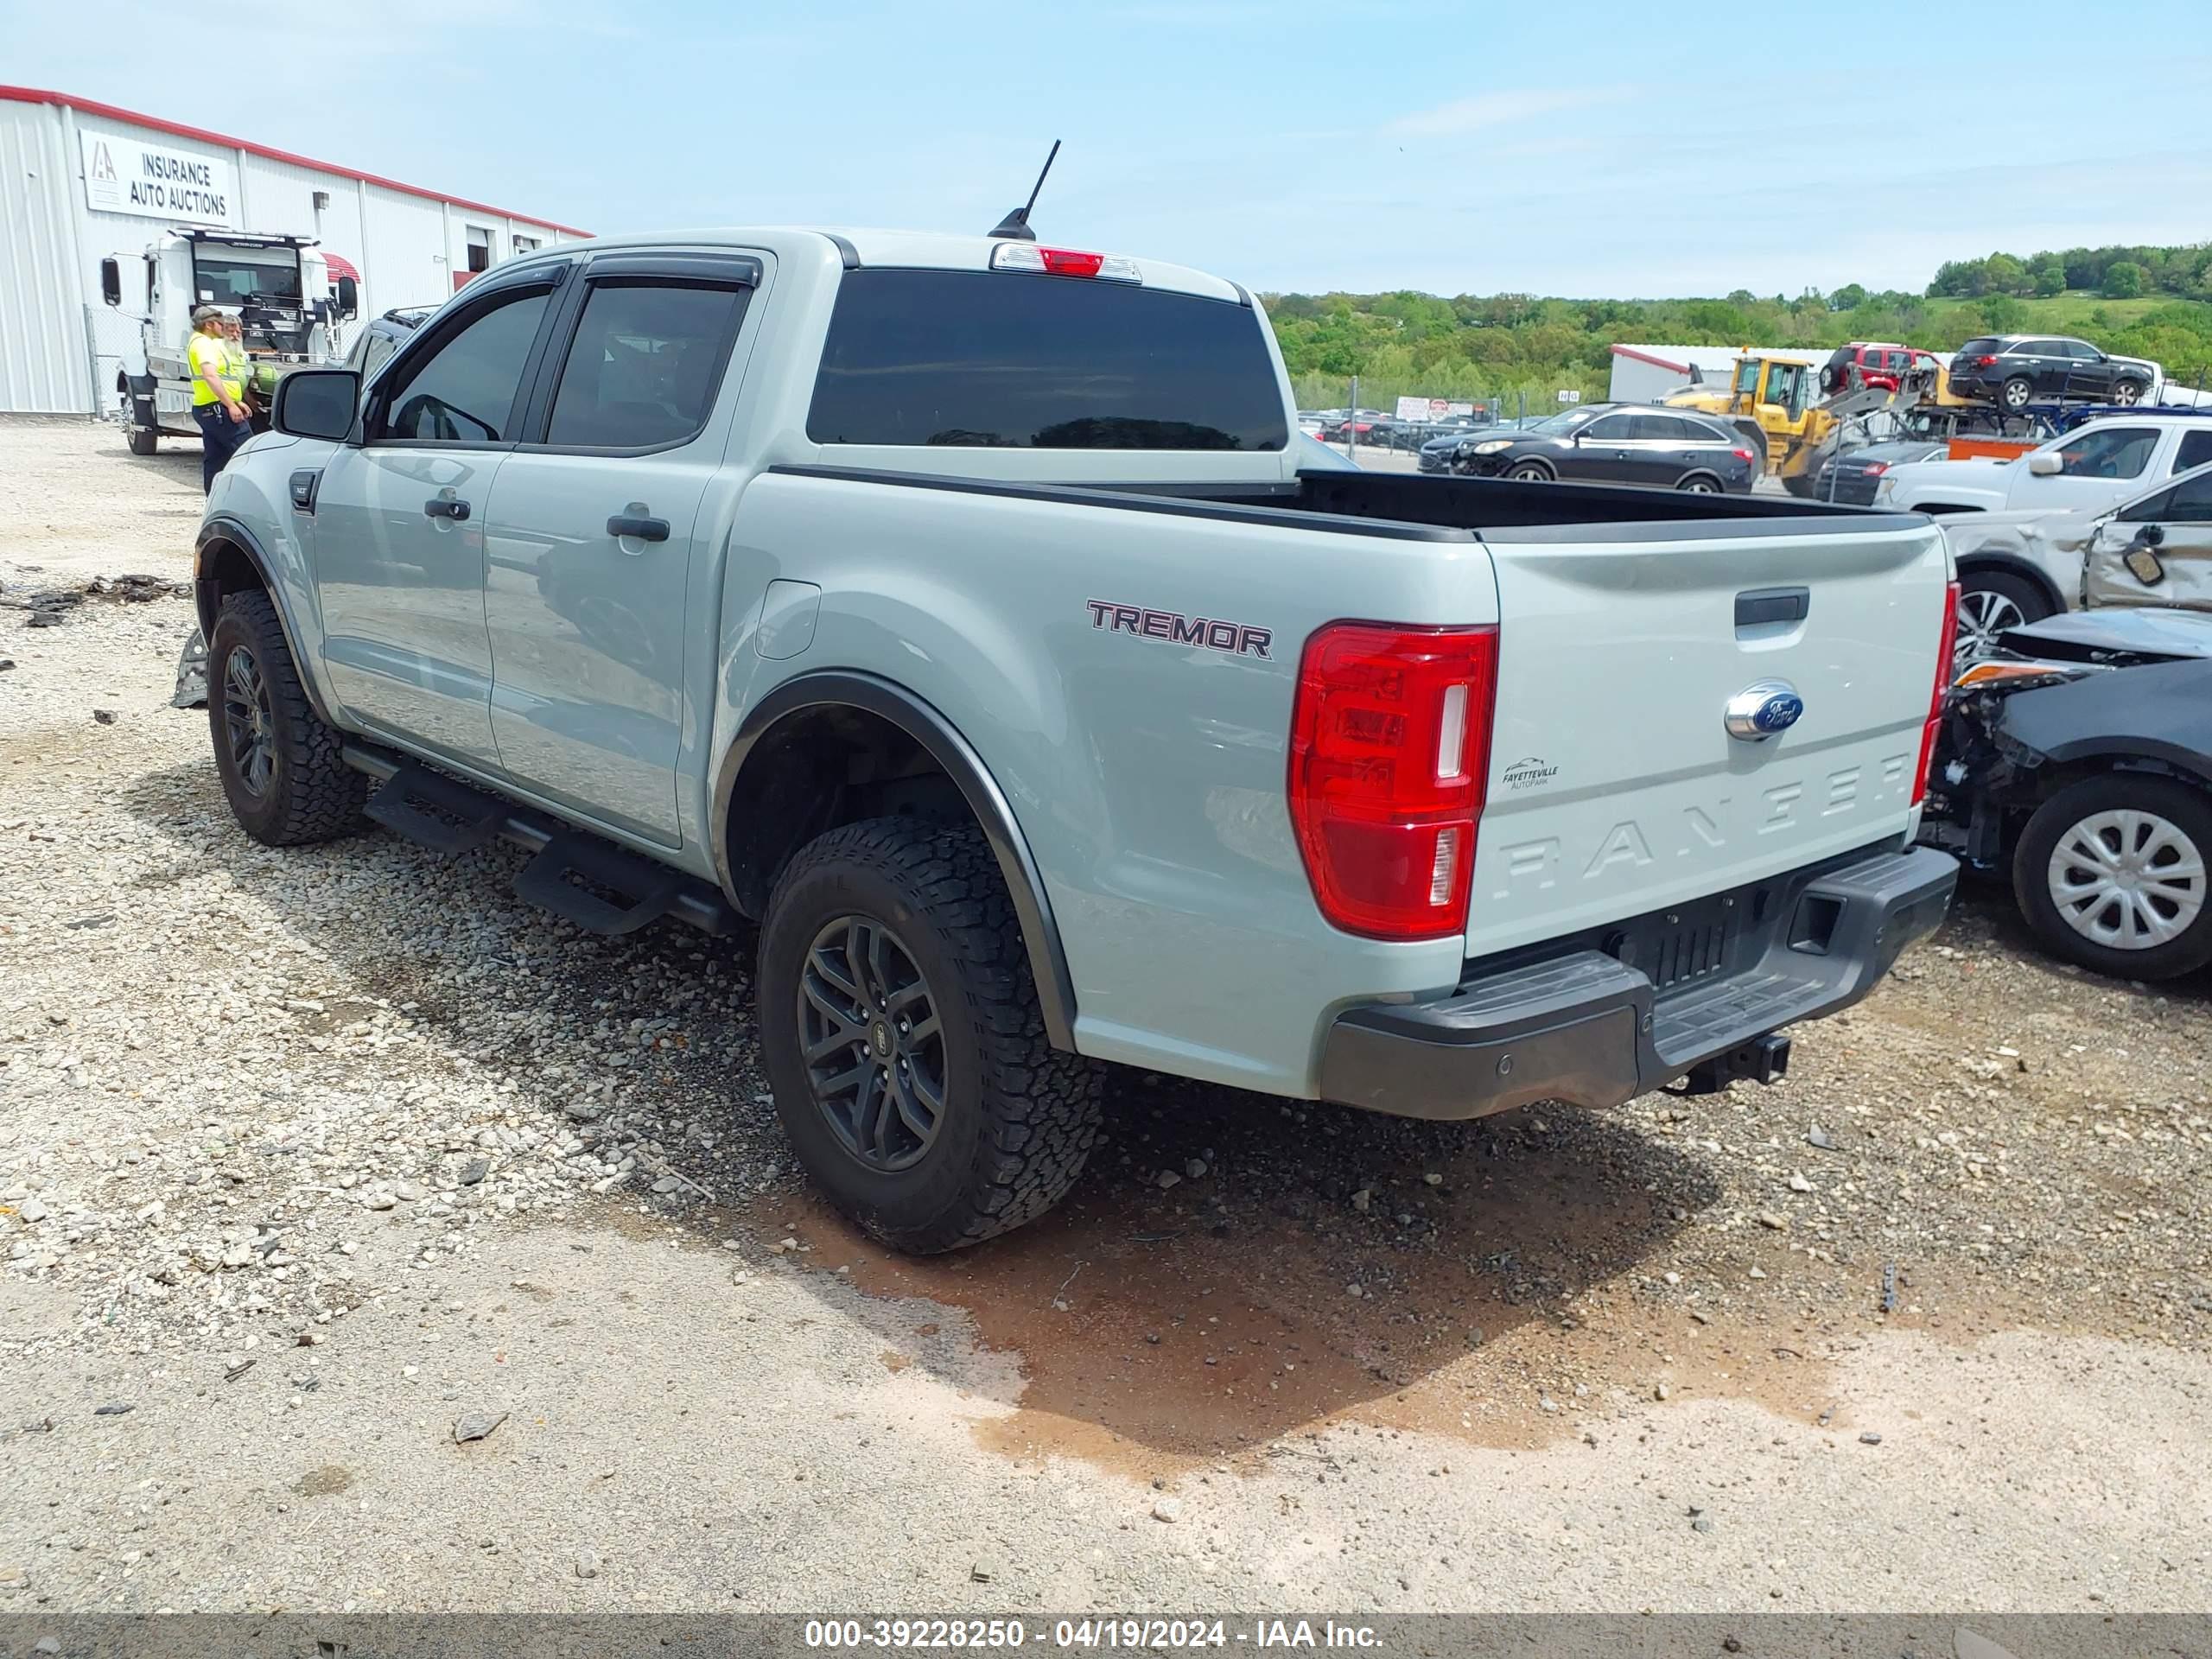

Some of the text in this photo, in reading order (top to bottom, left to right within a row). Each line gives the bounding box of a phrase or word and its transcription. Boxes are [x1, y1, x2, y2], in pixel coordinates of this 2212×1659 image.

[142, 153, 211, 188] INSURANCE
[130, 181, 226, 216] AUTO AUCTIONS
[1085, 597, 1274, 661] TREMOR
[1766, 699, 1797, 728] Ford
[1503, 766, 1559, 784] FAYETTEVILLE
[1493, 753, 1910, 899] RANGER
